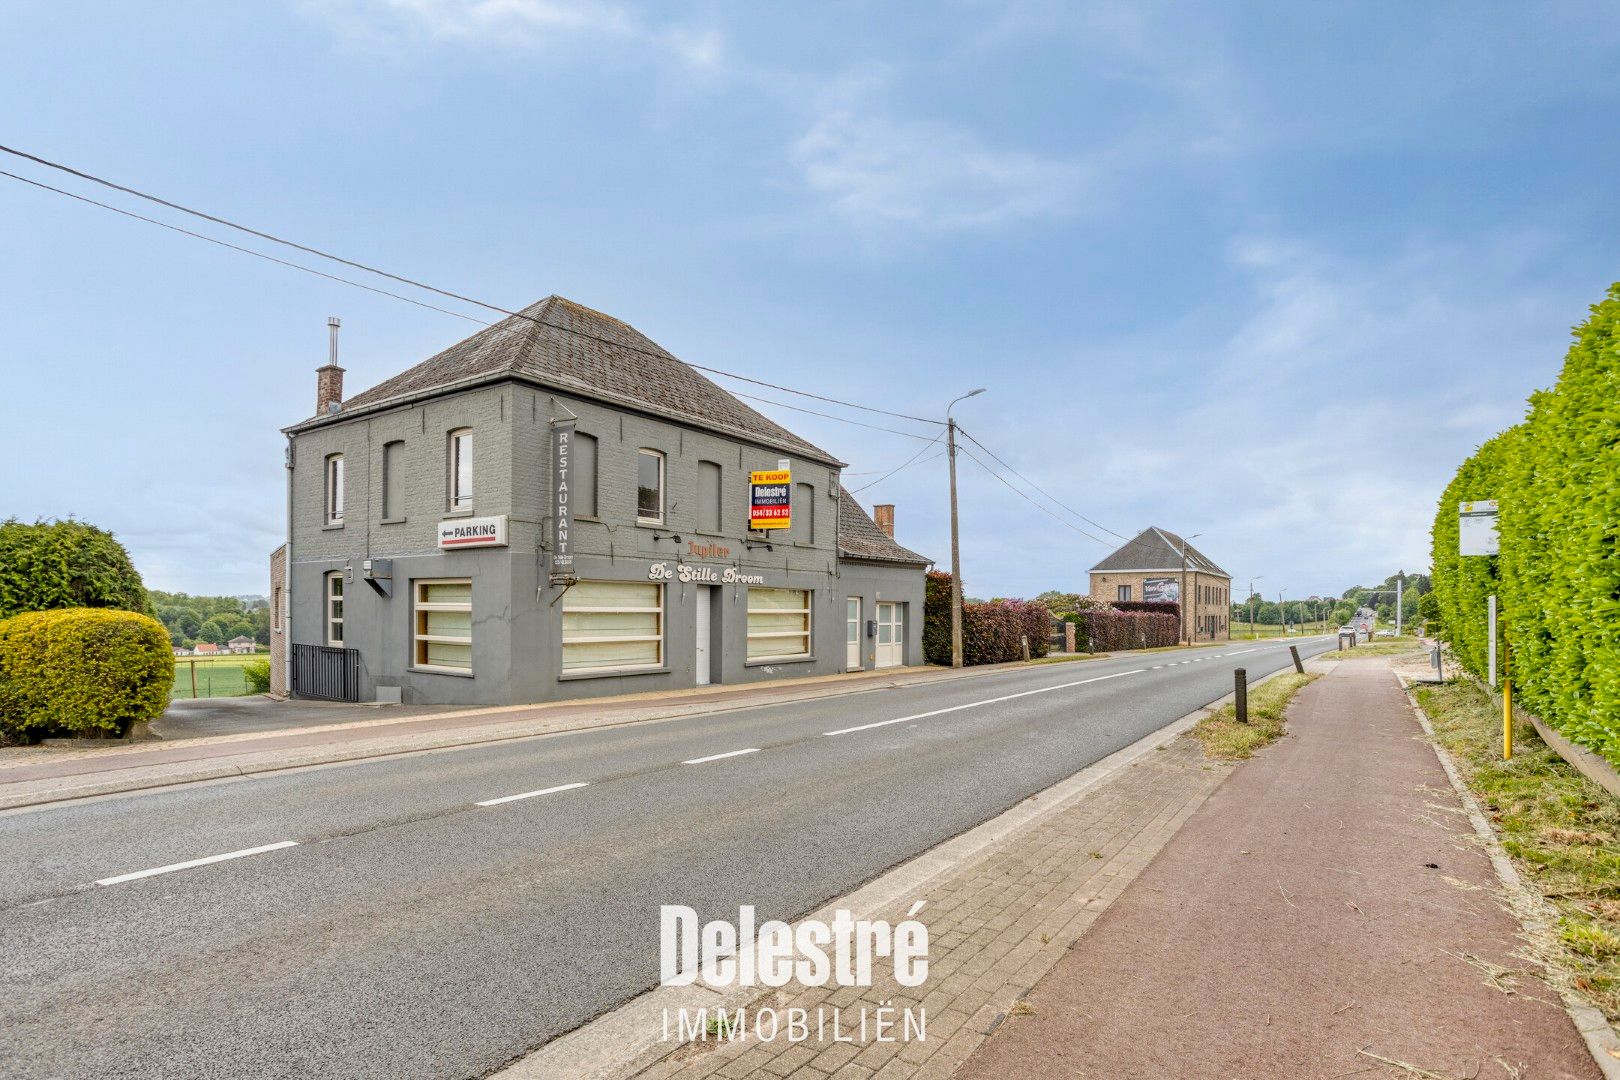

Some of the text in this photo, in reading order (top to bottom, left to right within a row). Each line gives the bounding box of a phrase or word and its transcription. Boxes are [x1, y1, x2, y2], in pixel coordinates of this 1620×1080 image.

[766, 473, 789, 481] KOOP
[559, 432, 568, 553] RESTAURANT
[755, 485, 787, 498] Delestré
[752, 509, 772, 517] 054/33
[781, 508, 789, 516] 52
[454, 524, 496, 538] PARKING
[687, 540, 731, 560] Jupiler
[648, 562, 764, 584] De Stille Droom
